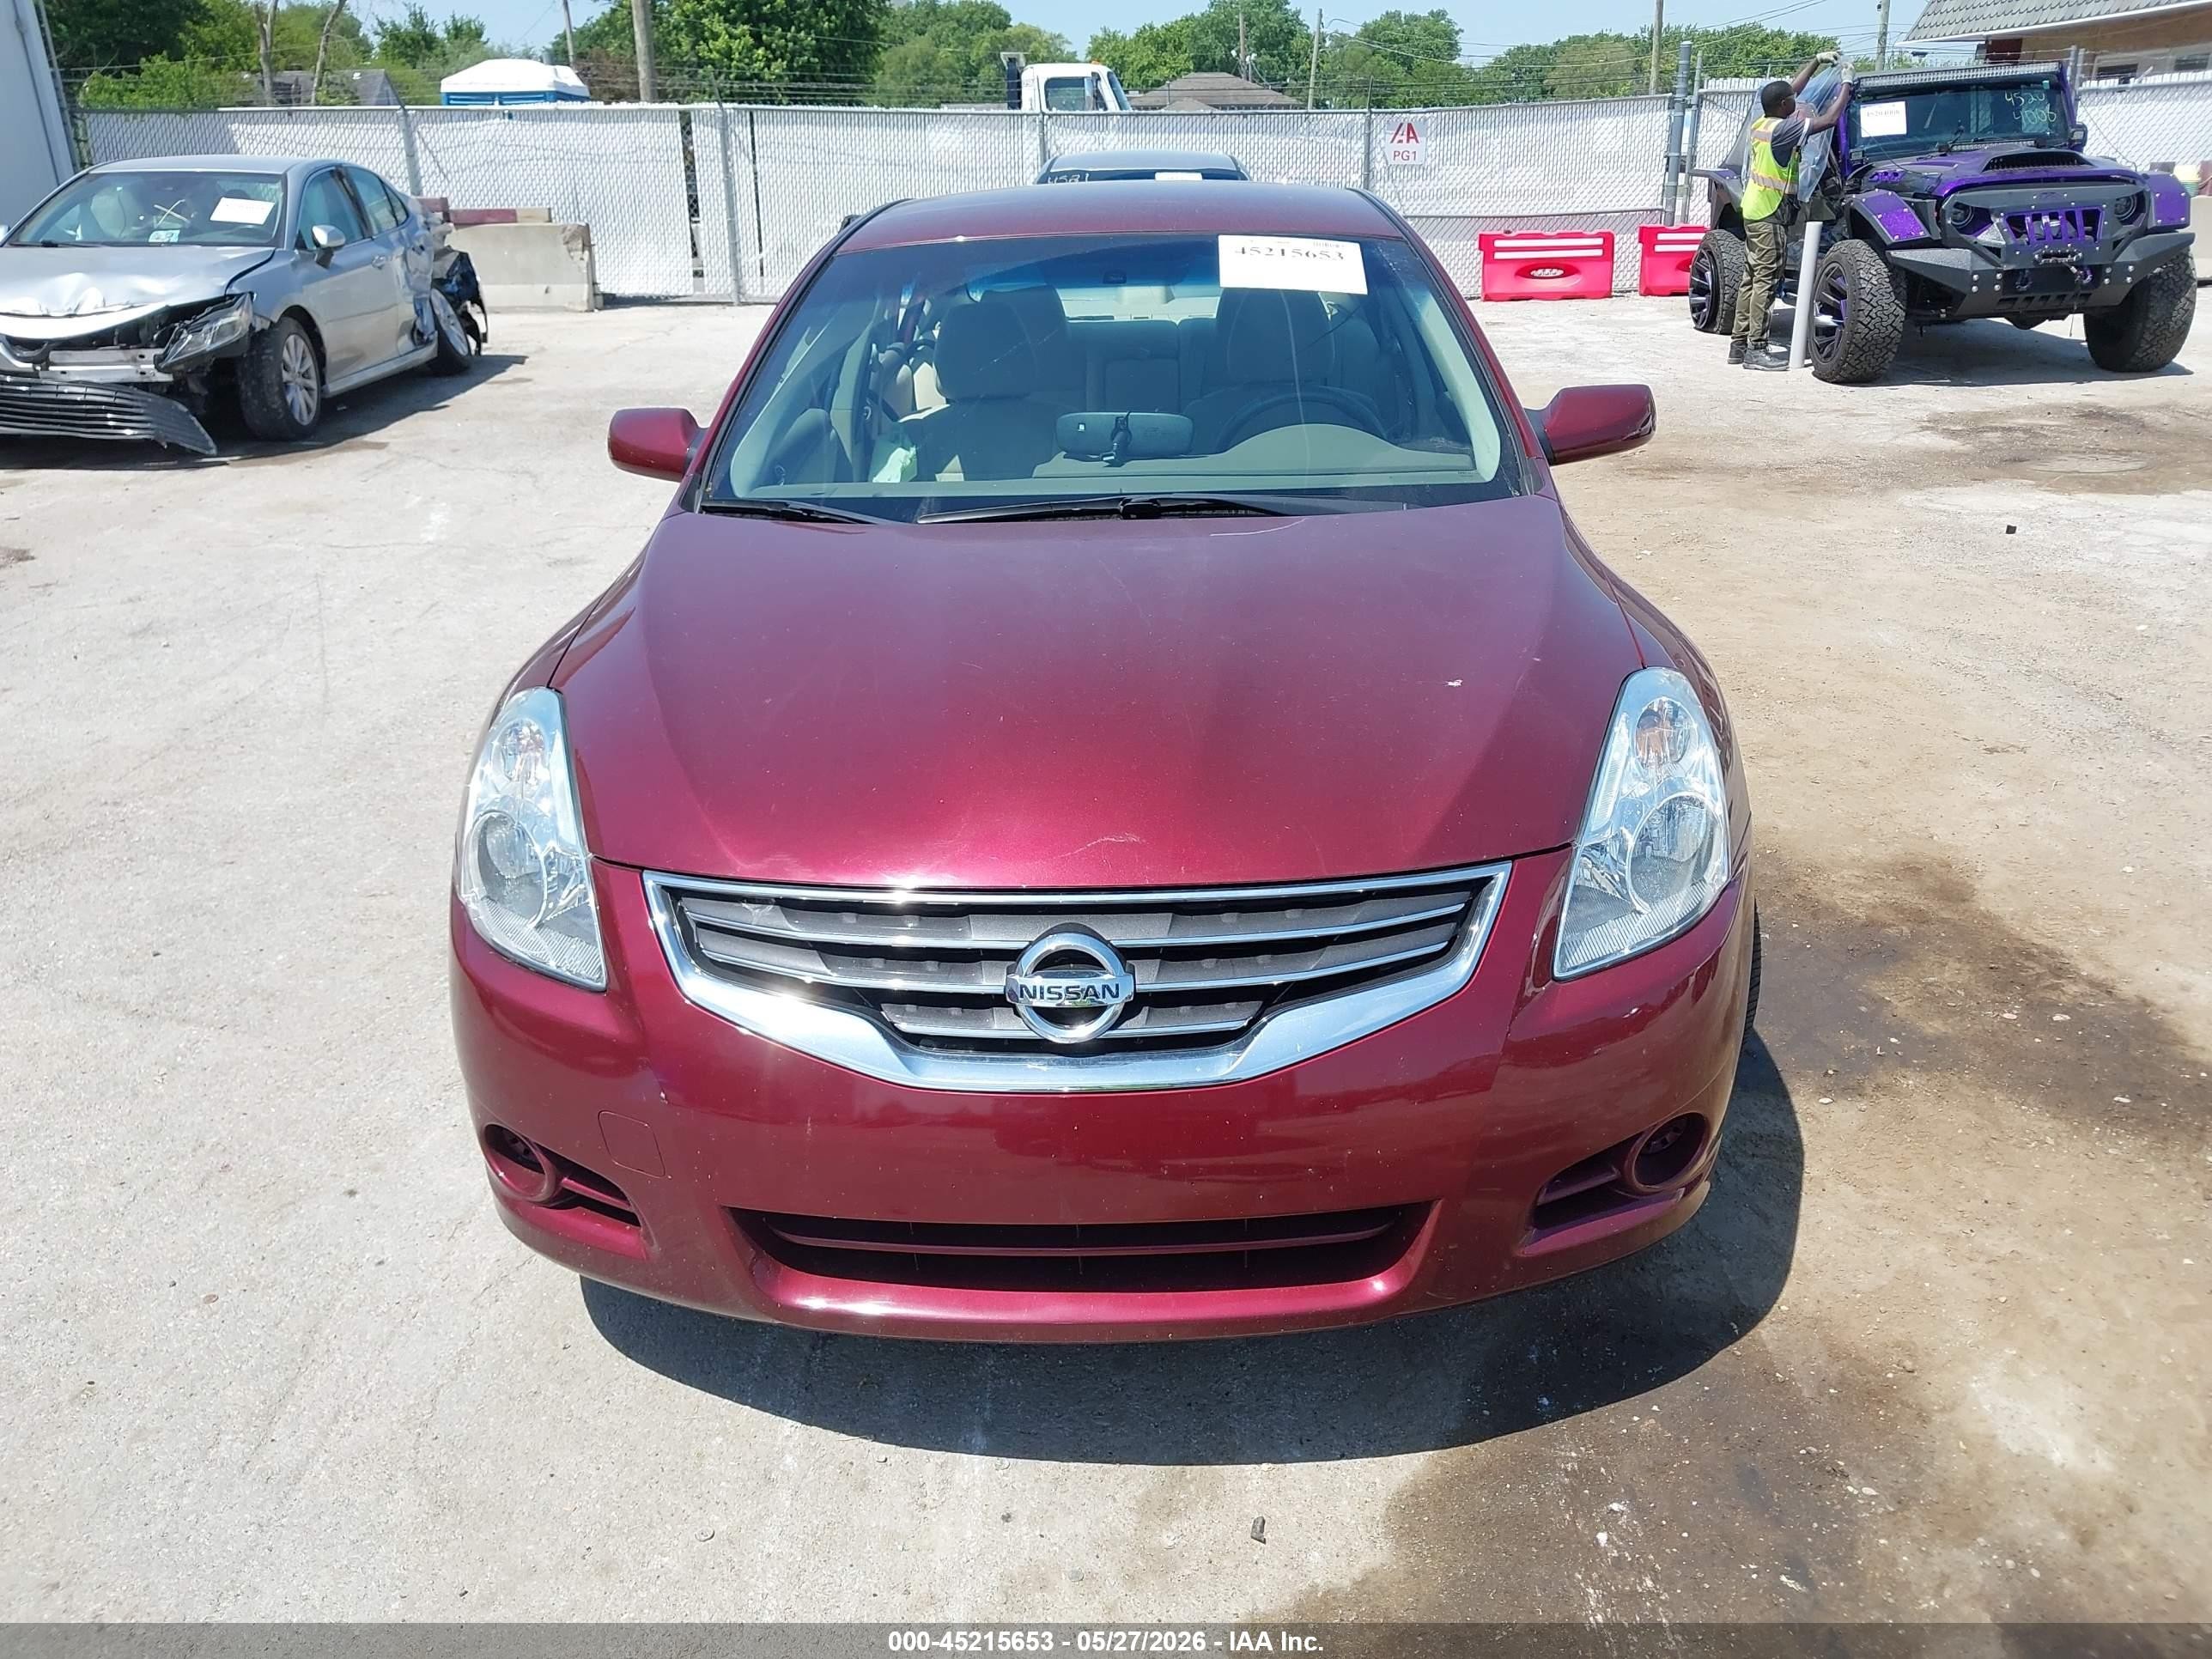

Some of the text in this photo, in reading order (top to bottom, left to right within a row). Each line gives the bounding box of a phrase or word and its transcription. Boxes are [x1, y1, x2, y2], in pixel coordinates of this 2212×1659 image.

[1393, 149, 1417, 161] PG1
[1235, 246, 1345, 262] 45215653
[1018, 983, 1120, 1001] NISSAN
